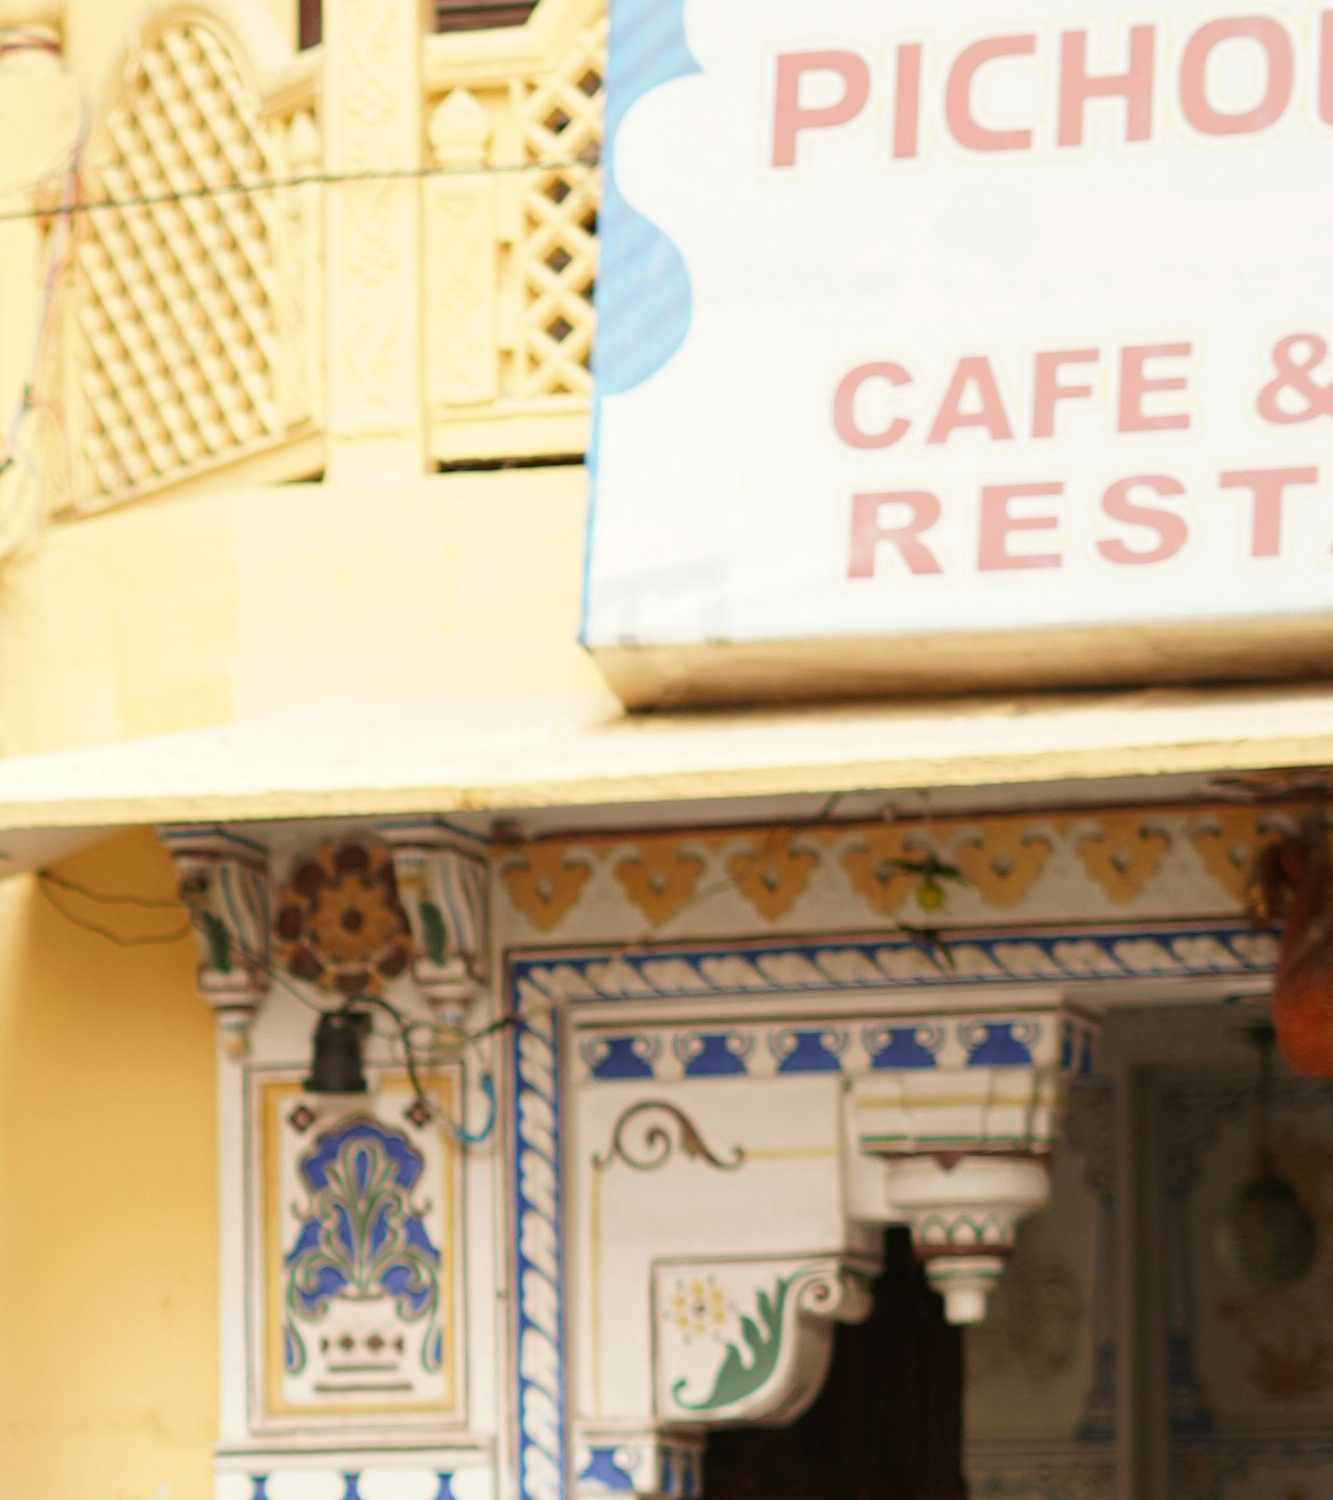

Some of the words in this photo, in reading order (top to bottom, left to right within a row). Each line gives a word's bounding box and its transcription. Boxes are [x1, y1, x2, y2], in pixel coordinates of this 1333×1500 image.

[768, 8, 1333, 170] PICHO
[829, 340, 1196, 451] CAFE
[1255, 332, 1333, 426] &
[843, 464, 1333, 581] REST
